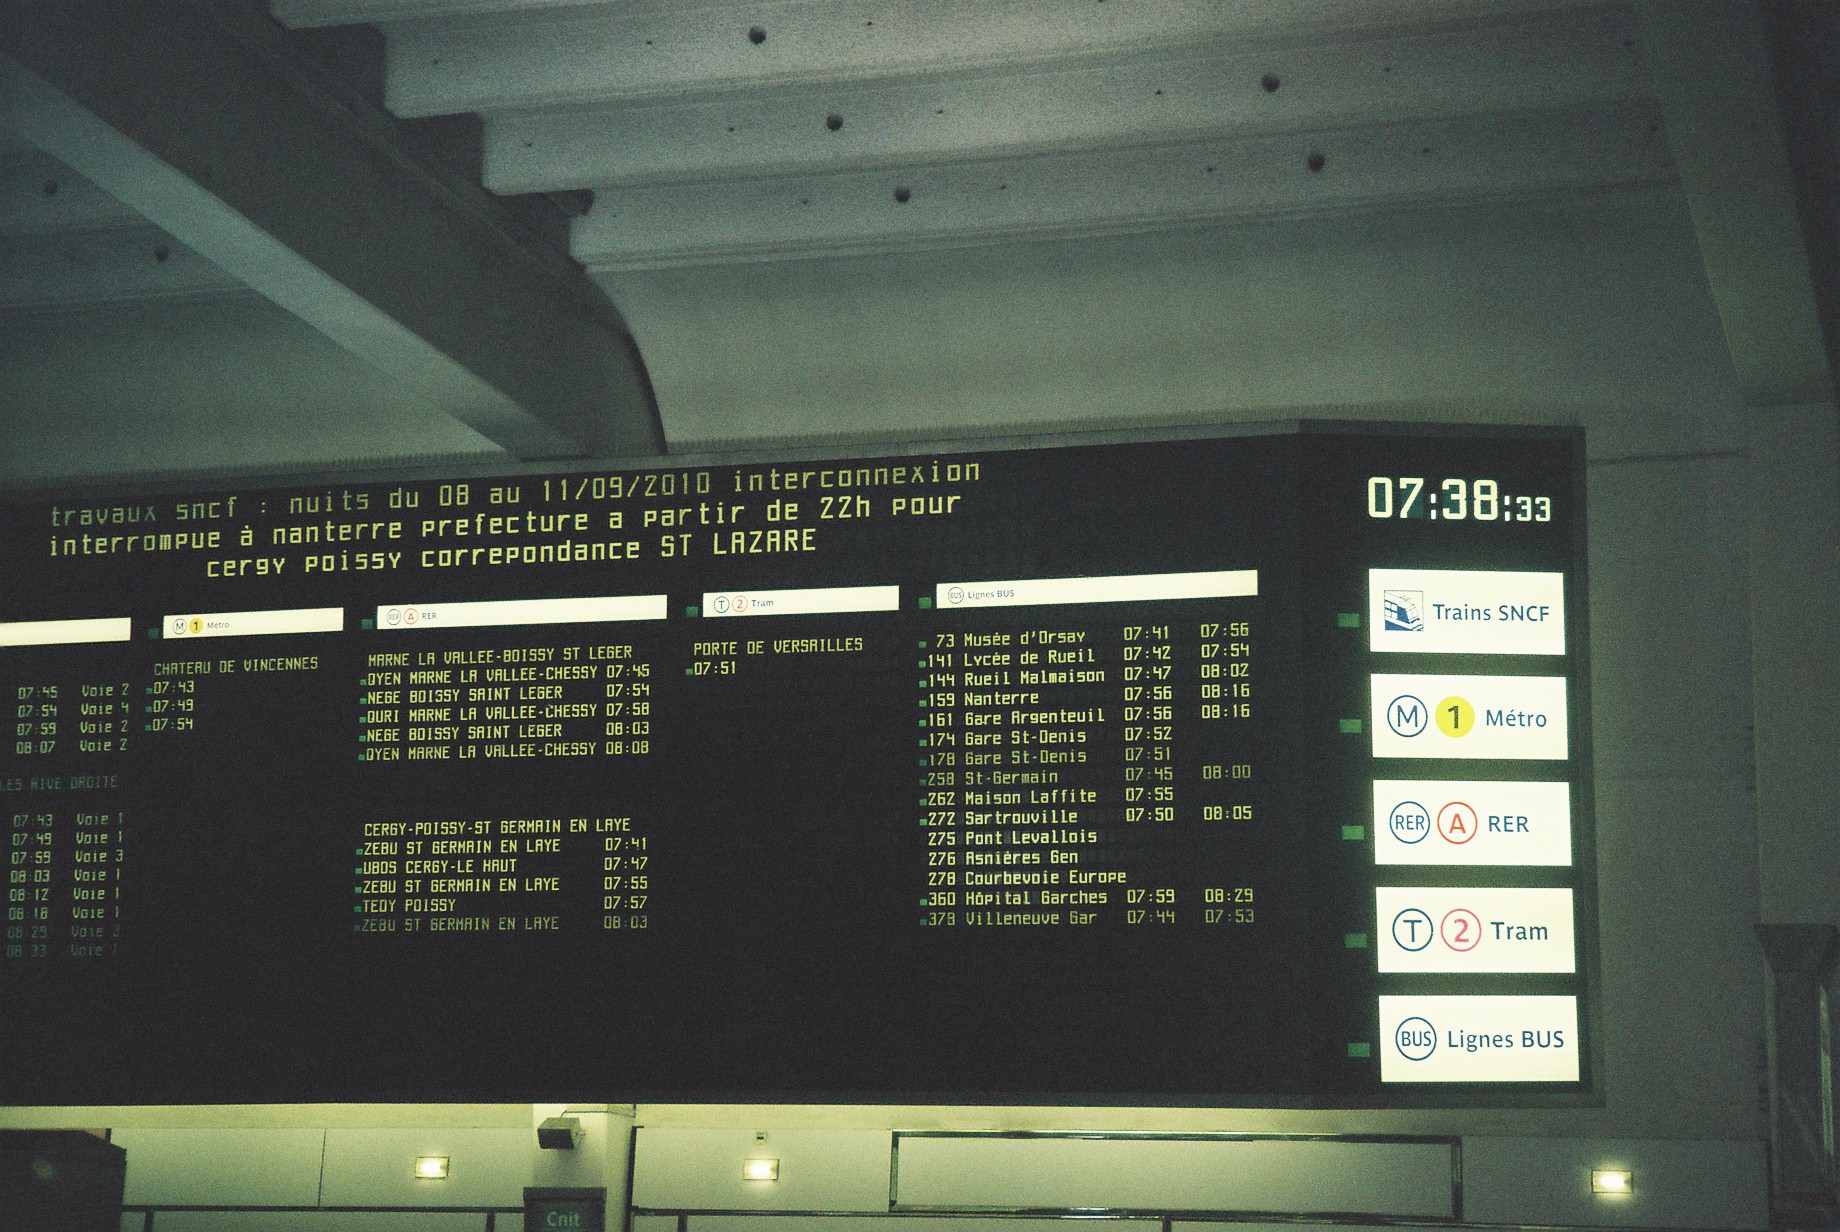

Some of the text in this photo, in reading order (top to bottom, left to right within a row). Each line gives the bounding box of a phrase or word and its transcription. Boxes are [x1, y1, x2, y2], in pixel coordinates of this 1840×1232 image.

[51, 505, 156, 527] travaux
[176, 497, 236, 521] sncf
[289, 490, 369, 514] nuits
[389, 487, 419, 508] du
[440, 484, 469, 507] 08
[490, 485, 520, 504] au
[543, 472, 711, 502] 11/09/2010
[735, 461, 980, 492] interconnexion
[50, 494, 961, 557] interrompue à nanterre prefecture a partir de 22h pour
[207, 528, 816, 577] cergy poissy correpondance ST LAZARE
[968, 590, 1014, 600] Lignes BUS
[718, 601, 725, 609] T
[738, 600, 743, 608] 2
[1433, 604, 1549, 622] Trains SNCF
[194, 622, 198, 630] 1
[937, 623, 1248, 647] 73 Musée d'Orsay 07:41 07:56
[694, 638, 862, 655] PORTE DE VERSAILLES
[929, 643, 1249, 667] 141 Lycée de Rueil 07:42 07:54
[369, 646, 632, 666] MARNE LA VALLEE-BOISSY ST LEGER
[155, 657, 317, 675] CHATEAU DE VINCENNES
[410, 671, 451, 684] MARNE
[461, 670, 477, 683] LA
[486, 666, 597, 681] VALLEE-CHESSY
[607, 664, 649, 678] 07:45
[694, 661, 735, 675] 07:51
[930, 663, 1248, 687] 144 Rueil Malmaison 07:47 08:02
[153, 680, 194, 694] 07:43
[368, 683, 649, 704] NEGE BOISSY SAINT LEGER 07:54
[930, 684, 1249, 706] 159 Nanterre 07:56 08:16
[152, 699, 193, 712] 07:49
[409, 708, 451, 721] MARNE
[460, 708, 476, 720] LA
[486, 704, 597, 719] VALLEE-CHESSY
[606, 702, 649, 716] 07:58
[930, 704, 1249, 726] 161 Gare Argenteuil 07:56 08:16
[1398, 705, 1546, 728] M 1 Métro
[152, 718, 193, 731] 07:54
[930, 726, 1172, 746] 174 Gare St-Denis 07:52
[929, 787, 1173, 805] 262 Maison Laffite 07:55
[928, 806, 1251, 825] 272 Sartrouville 07:50 08:05
[1395, 814, 1529, 833] RER A RER
[365, 818, 630, 836] CERGY-POISSY-ST GERMAIN EN LAYE
[364, 837, 646, 855] ZEBU ST GERMAIN EN LAYE 07:41
[929, 829, 1096, 845] 275 Pont Levallois
[363, 857, 648, 874] UBOS CERGY-LE HAUT 07:47
[929, 850, 1078, 865] 276 Asnières Gen
[929, 870, 1126, 885] 278 Courbevoie Europe
[363, 896, 647, 912] TEDY POISSY 07:57
[928, 888, 1253, 906] 360 Hôpital Garches 07:59 08:29
[1403, 919, 1548, 942] T 2 Tram
[1401, 1030, 1564, 1052] BUS Lignes BUS
